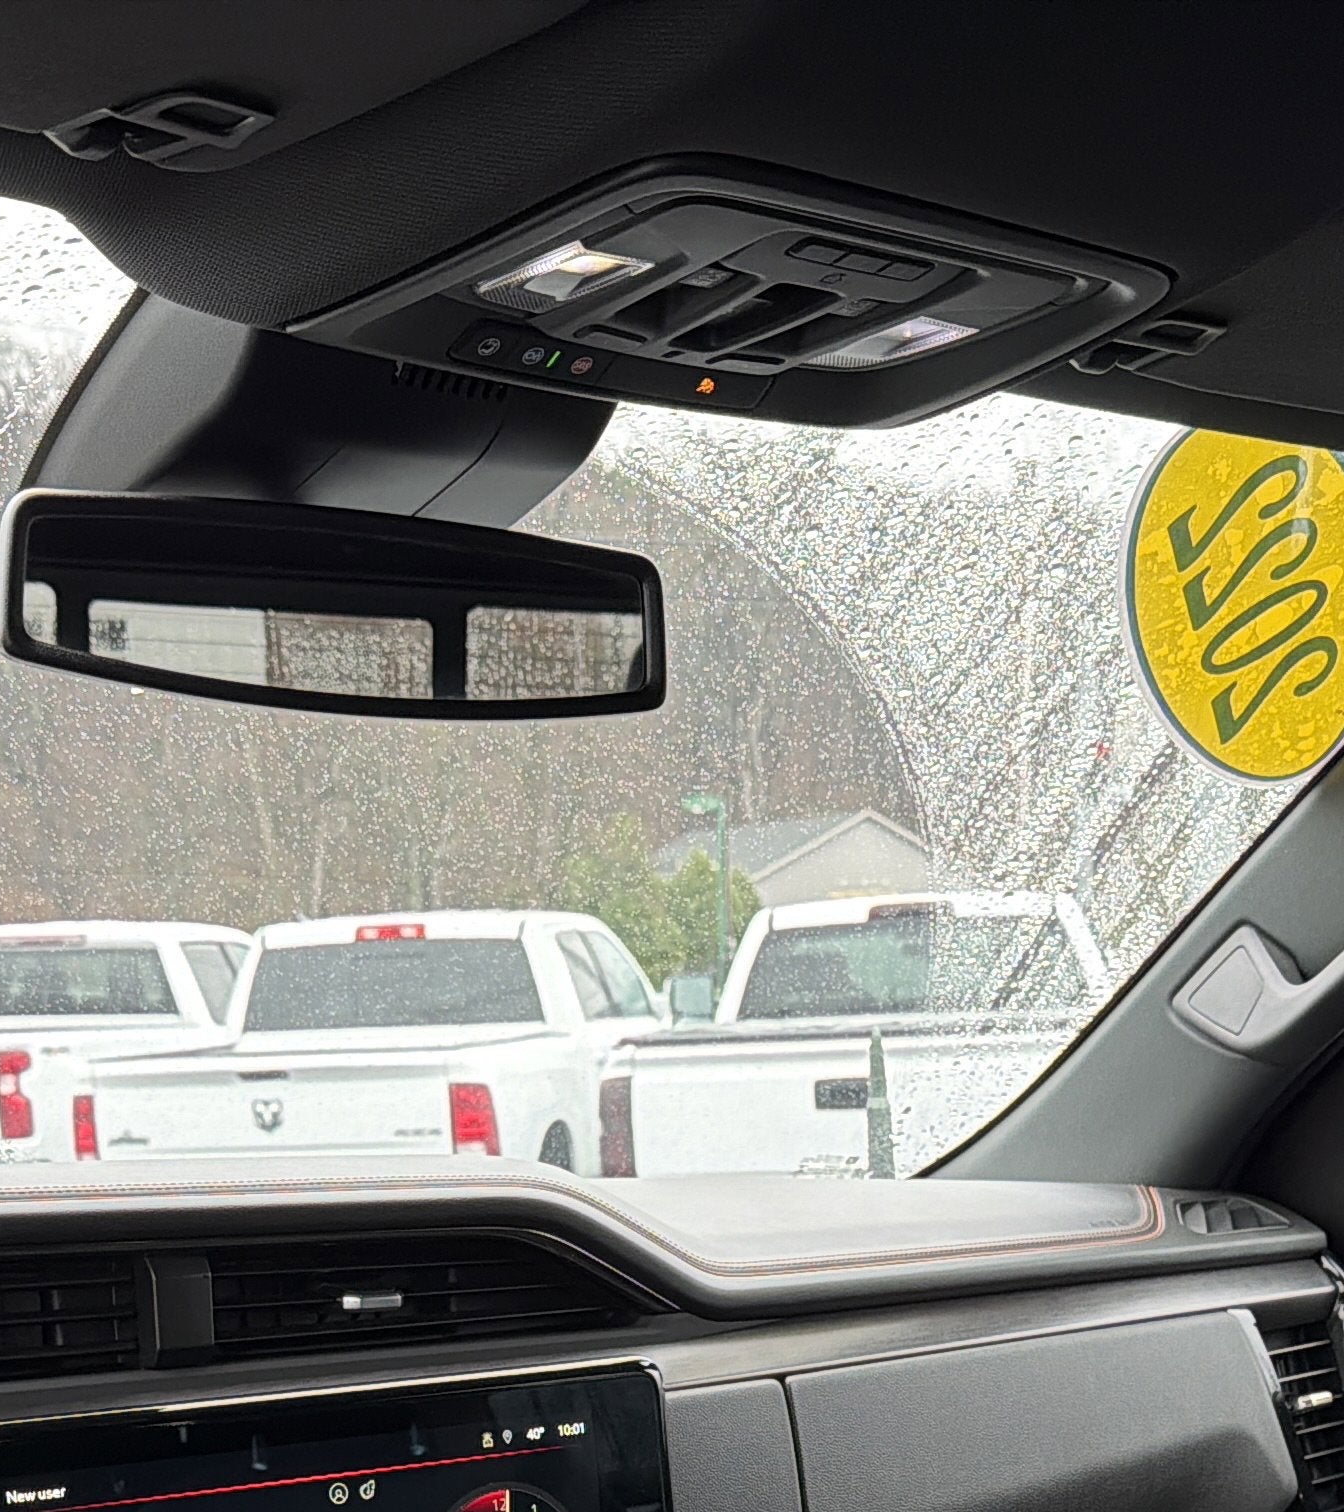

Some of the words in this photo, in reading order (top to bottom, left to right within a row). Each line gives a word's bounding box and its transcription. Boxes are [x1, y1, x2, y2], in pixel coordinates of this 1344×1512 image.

[558, 1423, 585, 1436] 10:01
[6, 1490, 35, 1504] New
[38, 1487, 66, 1499] user
[492, 1498, 507, 1512] 12
